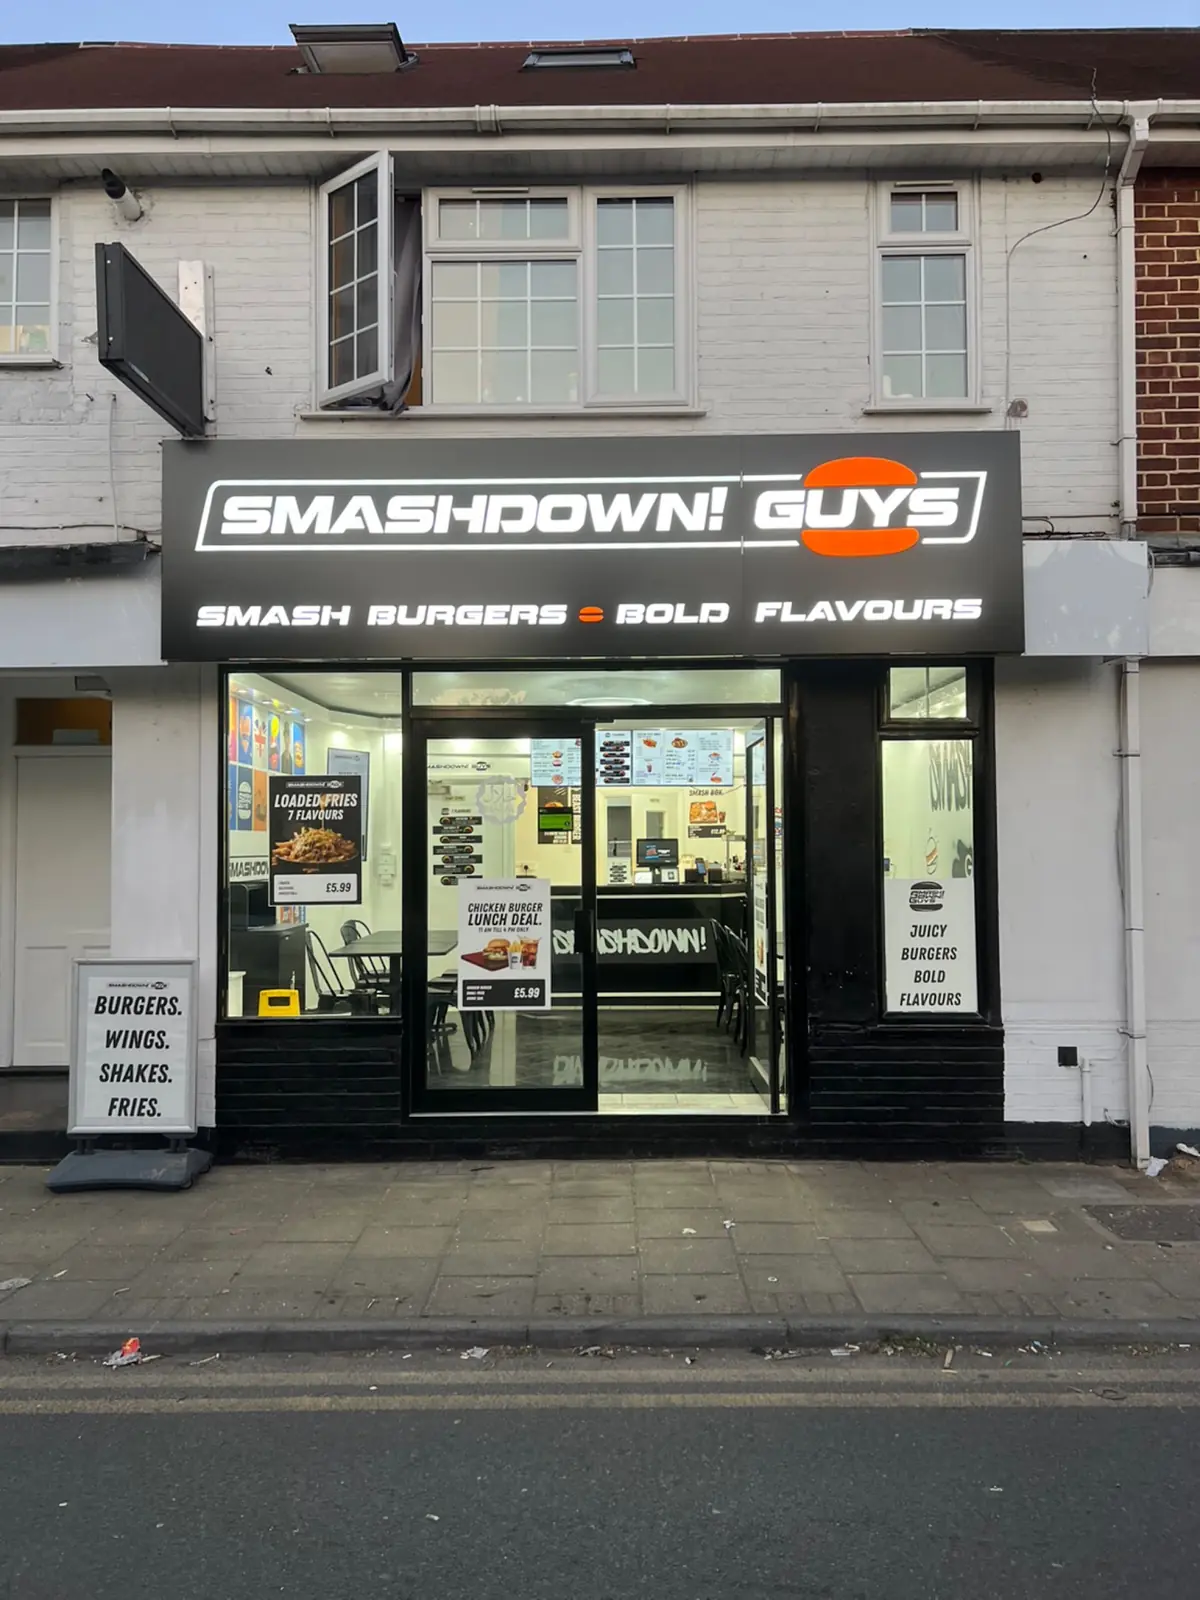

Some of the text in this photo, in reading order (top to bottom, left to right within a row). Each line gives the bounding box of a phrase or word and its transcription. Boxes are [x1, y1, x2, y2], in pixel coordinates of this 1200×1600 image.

[220, 486, 960, 535] SMASHDOWN! GUYS
[196, 598, 983, 627] SMASH BURGERS BOLD FLAVOURS
[274, 792, 358, 808] LOADED FRIES
[288, 809, 344, 821] 7 FLAVOURS
[326, 882, 351, 893] £5.99
[468, 902, 543, 912] CHICKEN BURGER
[468, 913, 542, 926] LUNCH DEAL.
[910, 924, 947, 938] JUICY
[552, 926, 707, 955] SSHDOWN!
[901, 946, 958, 961] BURGERS
[914, 969, 946, 983] BOLD
[514, 987, 540, 999] £5.99
[899, 992, 962, 1006] FLAVOURS
[94, 995, 182, 1016] BURGERS.
[105, 1029, 170, 1050] WINGS.
[99, 1063, 173, 1083] SHAKES.
[108, 1097, 161, 1117] FRIES.
